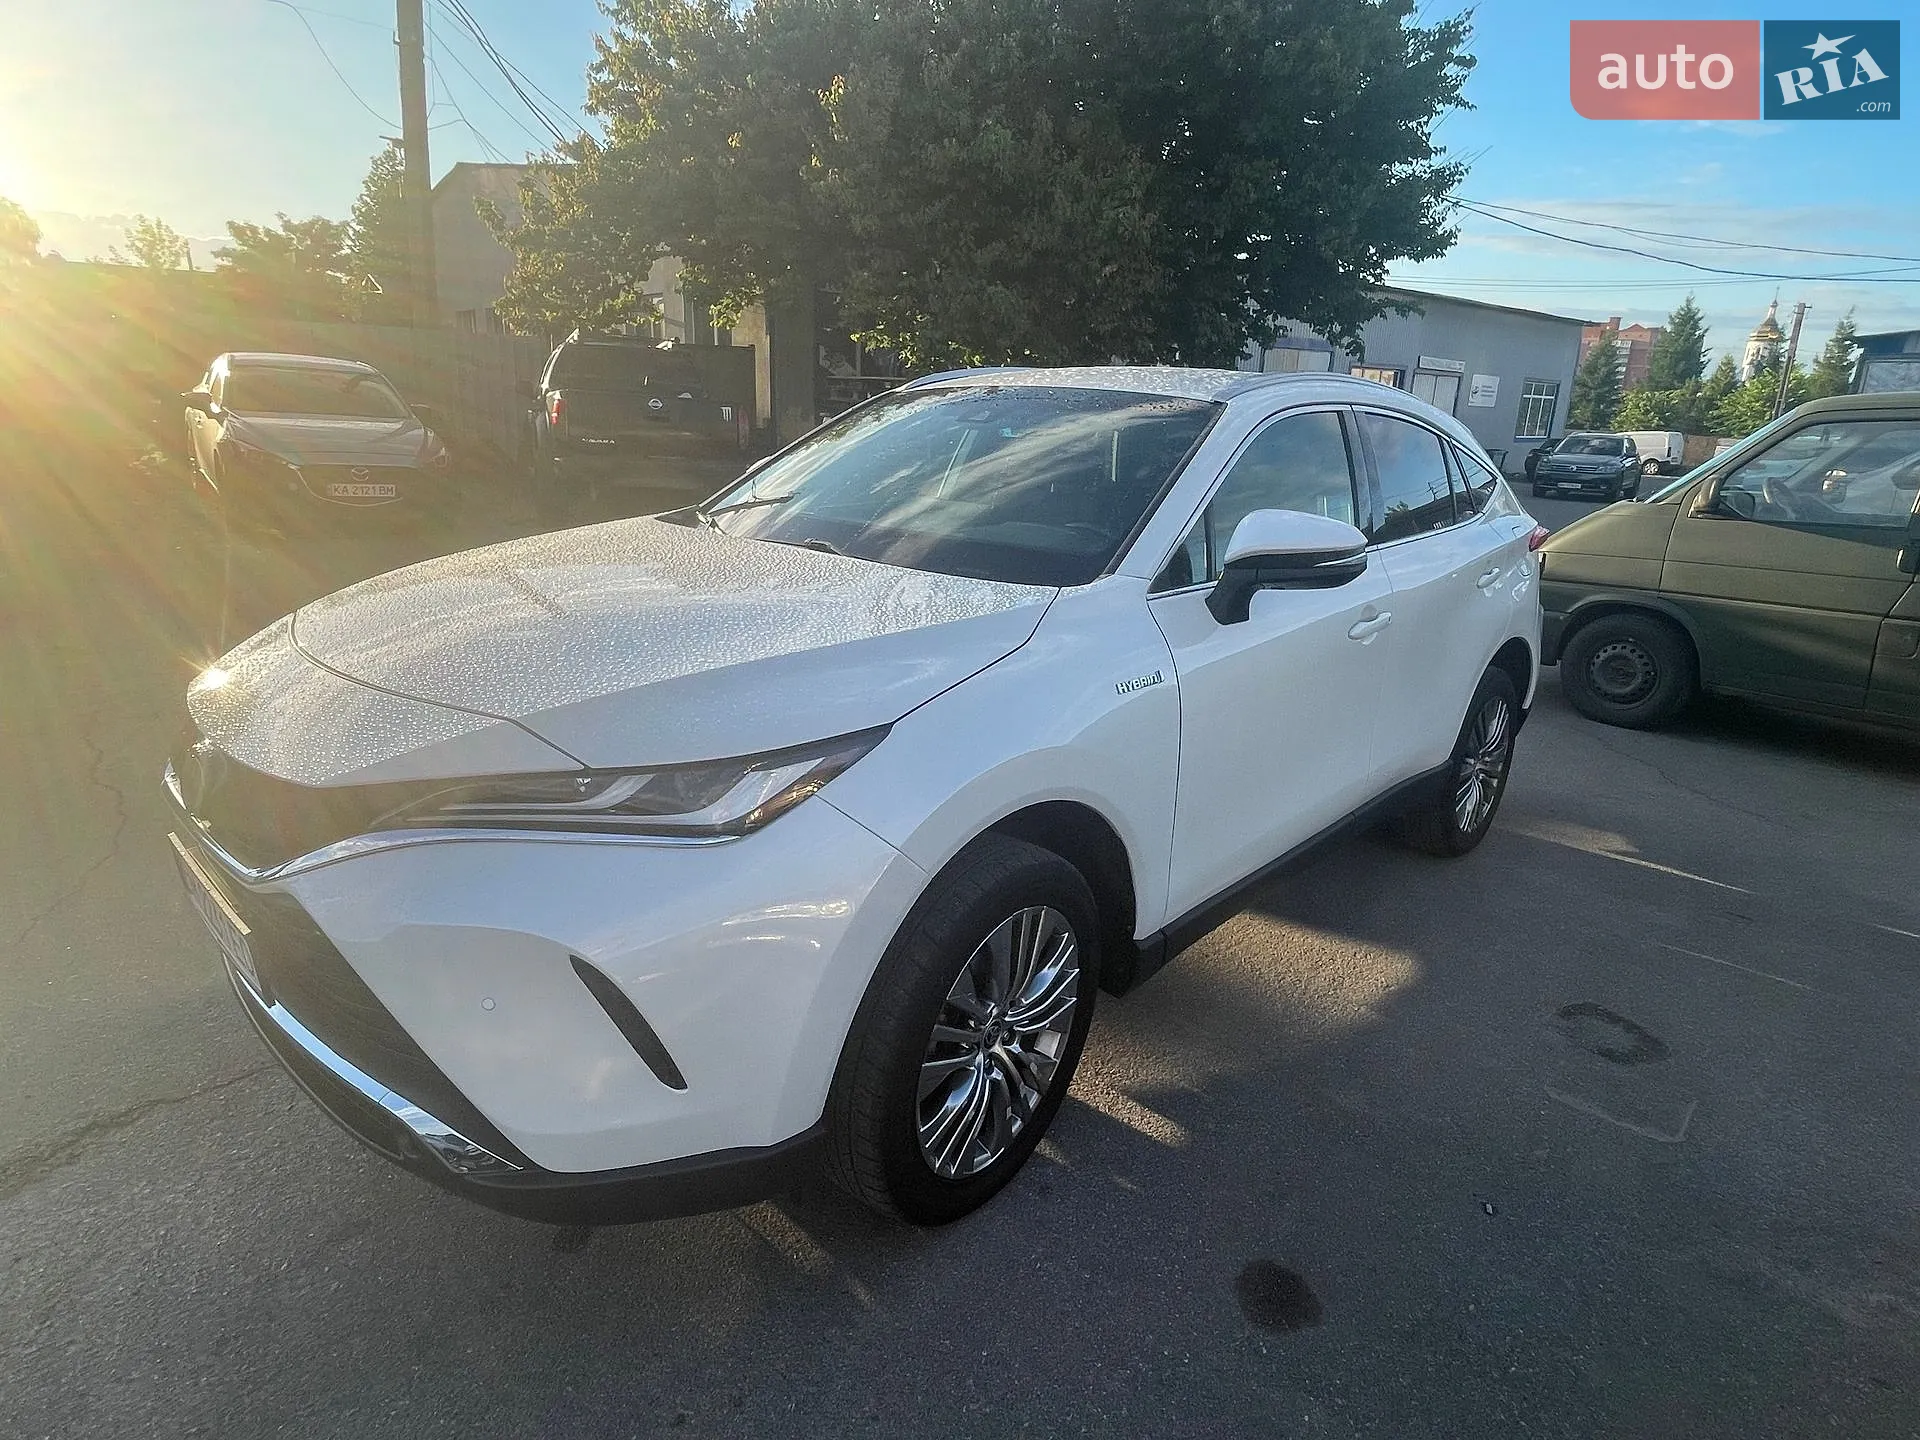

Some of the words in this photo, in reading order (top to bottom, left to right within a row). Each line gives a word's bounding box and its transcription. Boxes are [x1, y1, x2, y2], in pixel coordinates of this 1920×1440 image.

[333, 485, 348, 495] KA
[351, 485, 376, 495] 2121
[378, 485, 394, 495] BM
[1115, 670, 1164, 695] HYBRID
